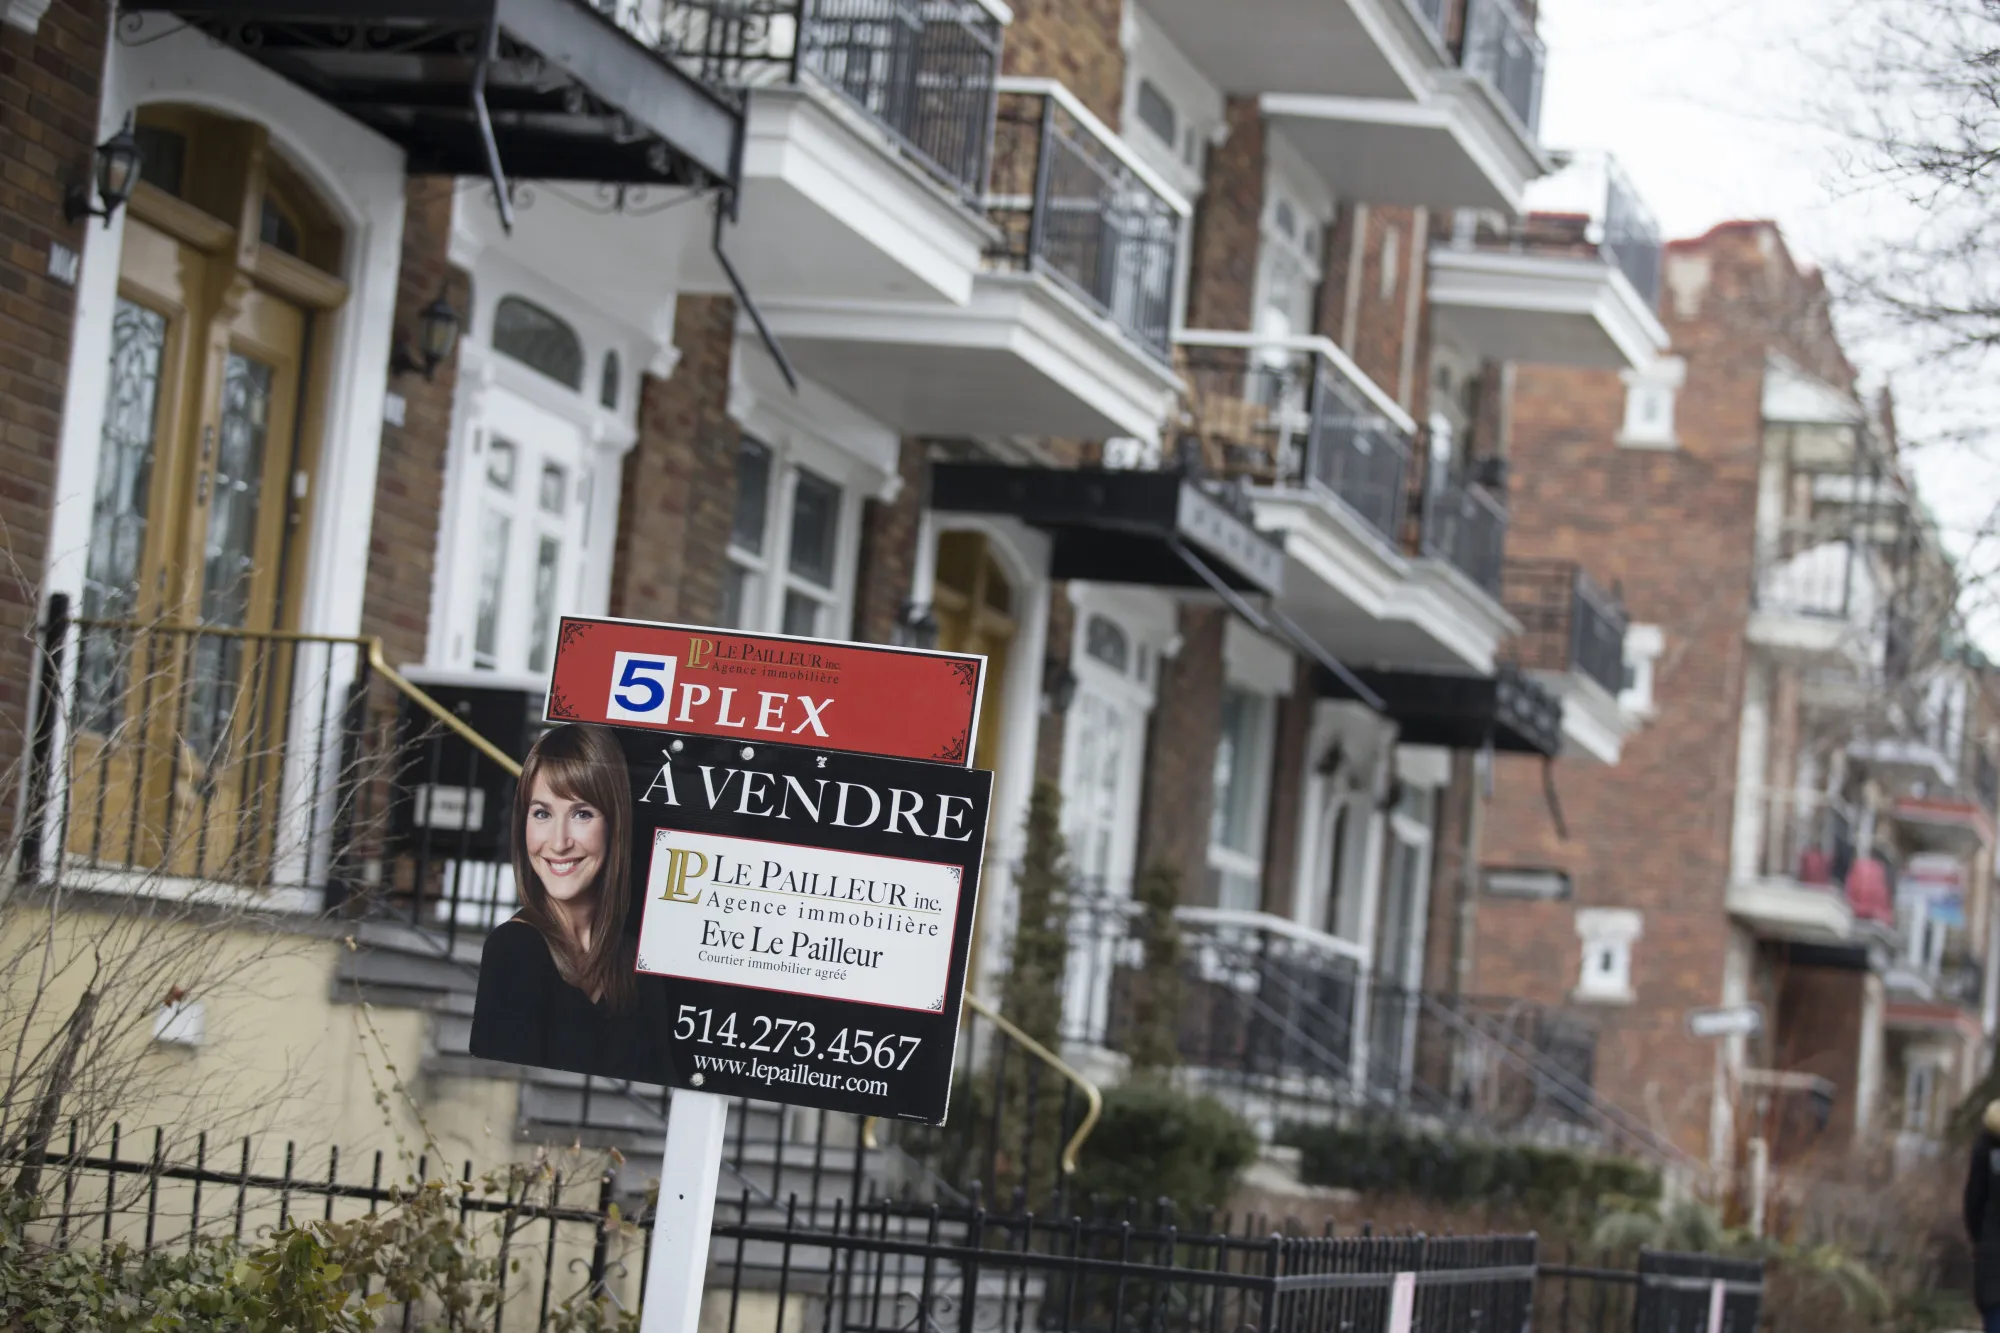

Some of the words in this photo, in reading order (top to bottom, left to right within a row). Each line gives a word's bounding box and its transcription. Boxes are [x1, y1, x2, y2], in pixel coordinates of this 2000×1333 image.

[712, 662, 756, 675] Agence
[762, 667, 839, 684] immobilière
[714, 641, 737, 659] LE
[741, 643, 821, 668] PAILLEUR
[825, 659, 841, 670] inc.
[613, 658, 666, 713] 5
[674, 682, 835, 738] PLEX
[638, 749, 681, 806] À
[698, 764, 974, 842] VENDRE
[711, 854, 752, 886] LE
[759, 860, 907, 907] PAILLEUR
[914, 892, 942, 911] inc.
[706, 891, 787, 916] Agence
[798, 902, 938, 936] immobilière
[698, 950, 745, 967] Courtier
[748, 956, 812, 976] immobilier
[815, 968, 847, 981] agréé
[700, 919, 745, 949] Eve
[749, 926, 784, 955] Le
[788, 931, 884, 969] Pailleur
[674, 1004, 922, 1072] 514.273.4567
[693, 1054, 888, 1096] www.lepailleur.com
